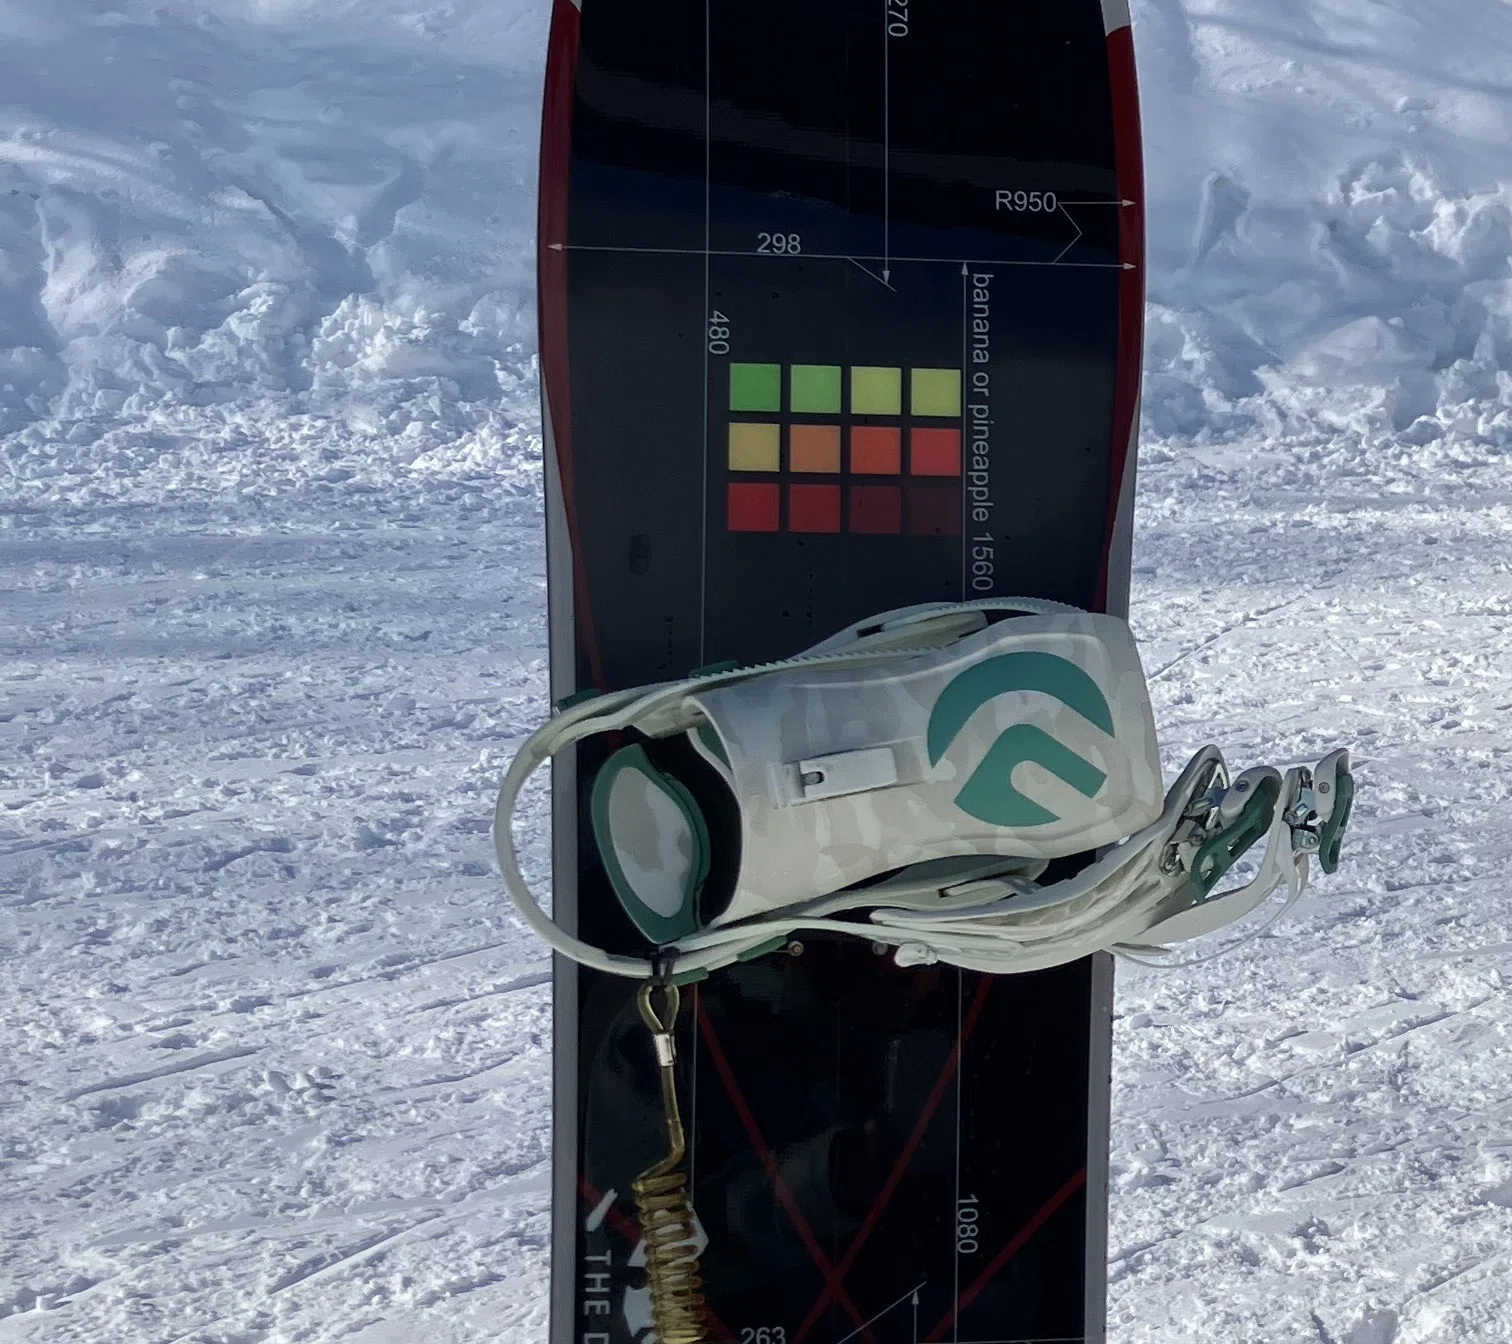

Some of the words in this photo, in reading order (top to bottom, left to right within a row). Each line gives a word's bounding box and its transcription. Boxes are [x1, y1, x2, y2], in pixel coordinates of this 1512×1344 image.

[995, 190, 1057, 213] R950
[757, 232, 801, 255] 298
[708, 309, 730, 355] 480
[972, 273, 994, 365] banana
[972, 374, 989, 397] or
[967, 402, 994, 522] pineapple
[971, 533, 994, 591] 1560
[957, 1194, 979, 1253] 1080
[584, 1249, 612, 1316] THE
